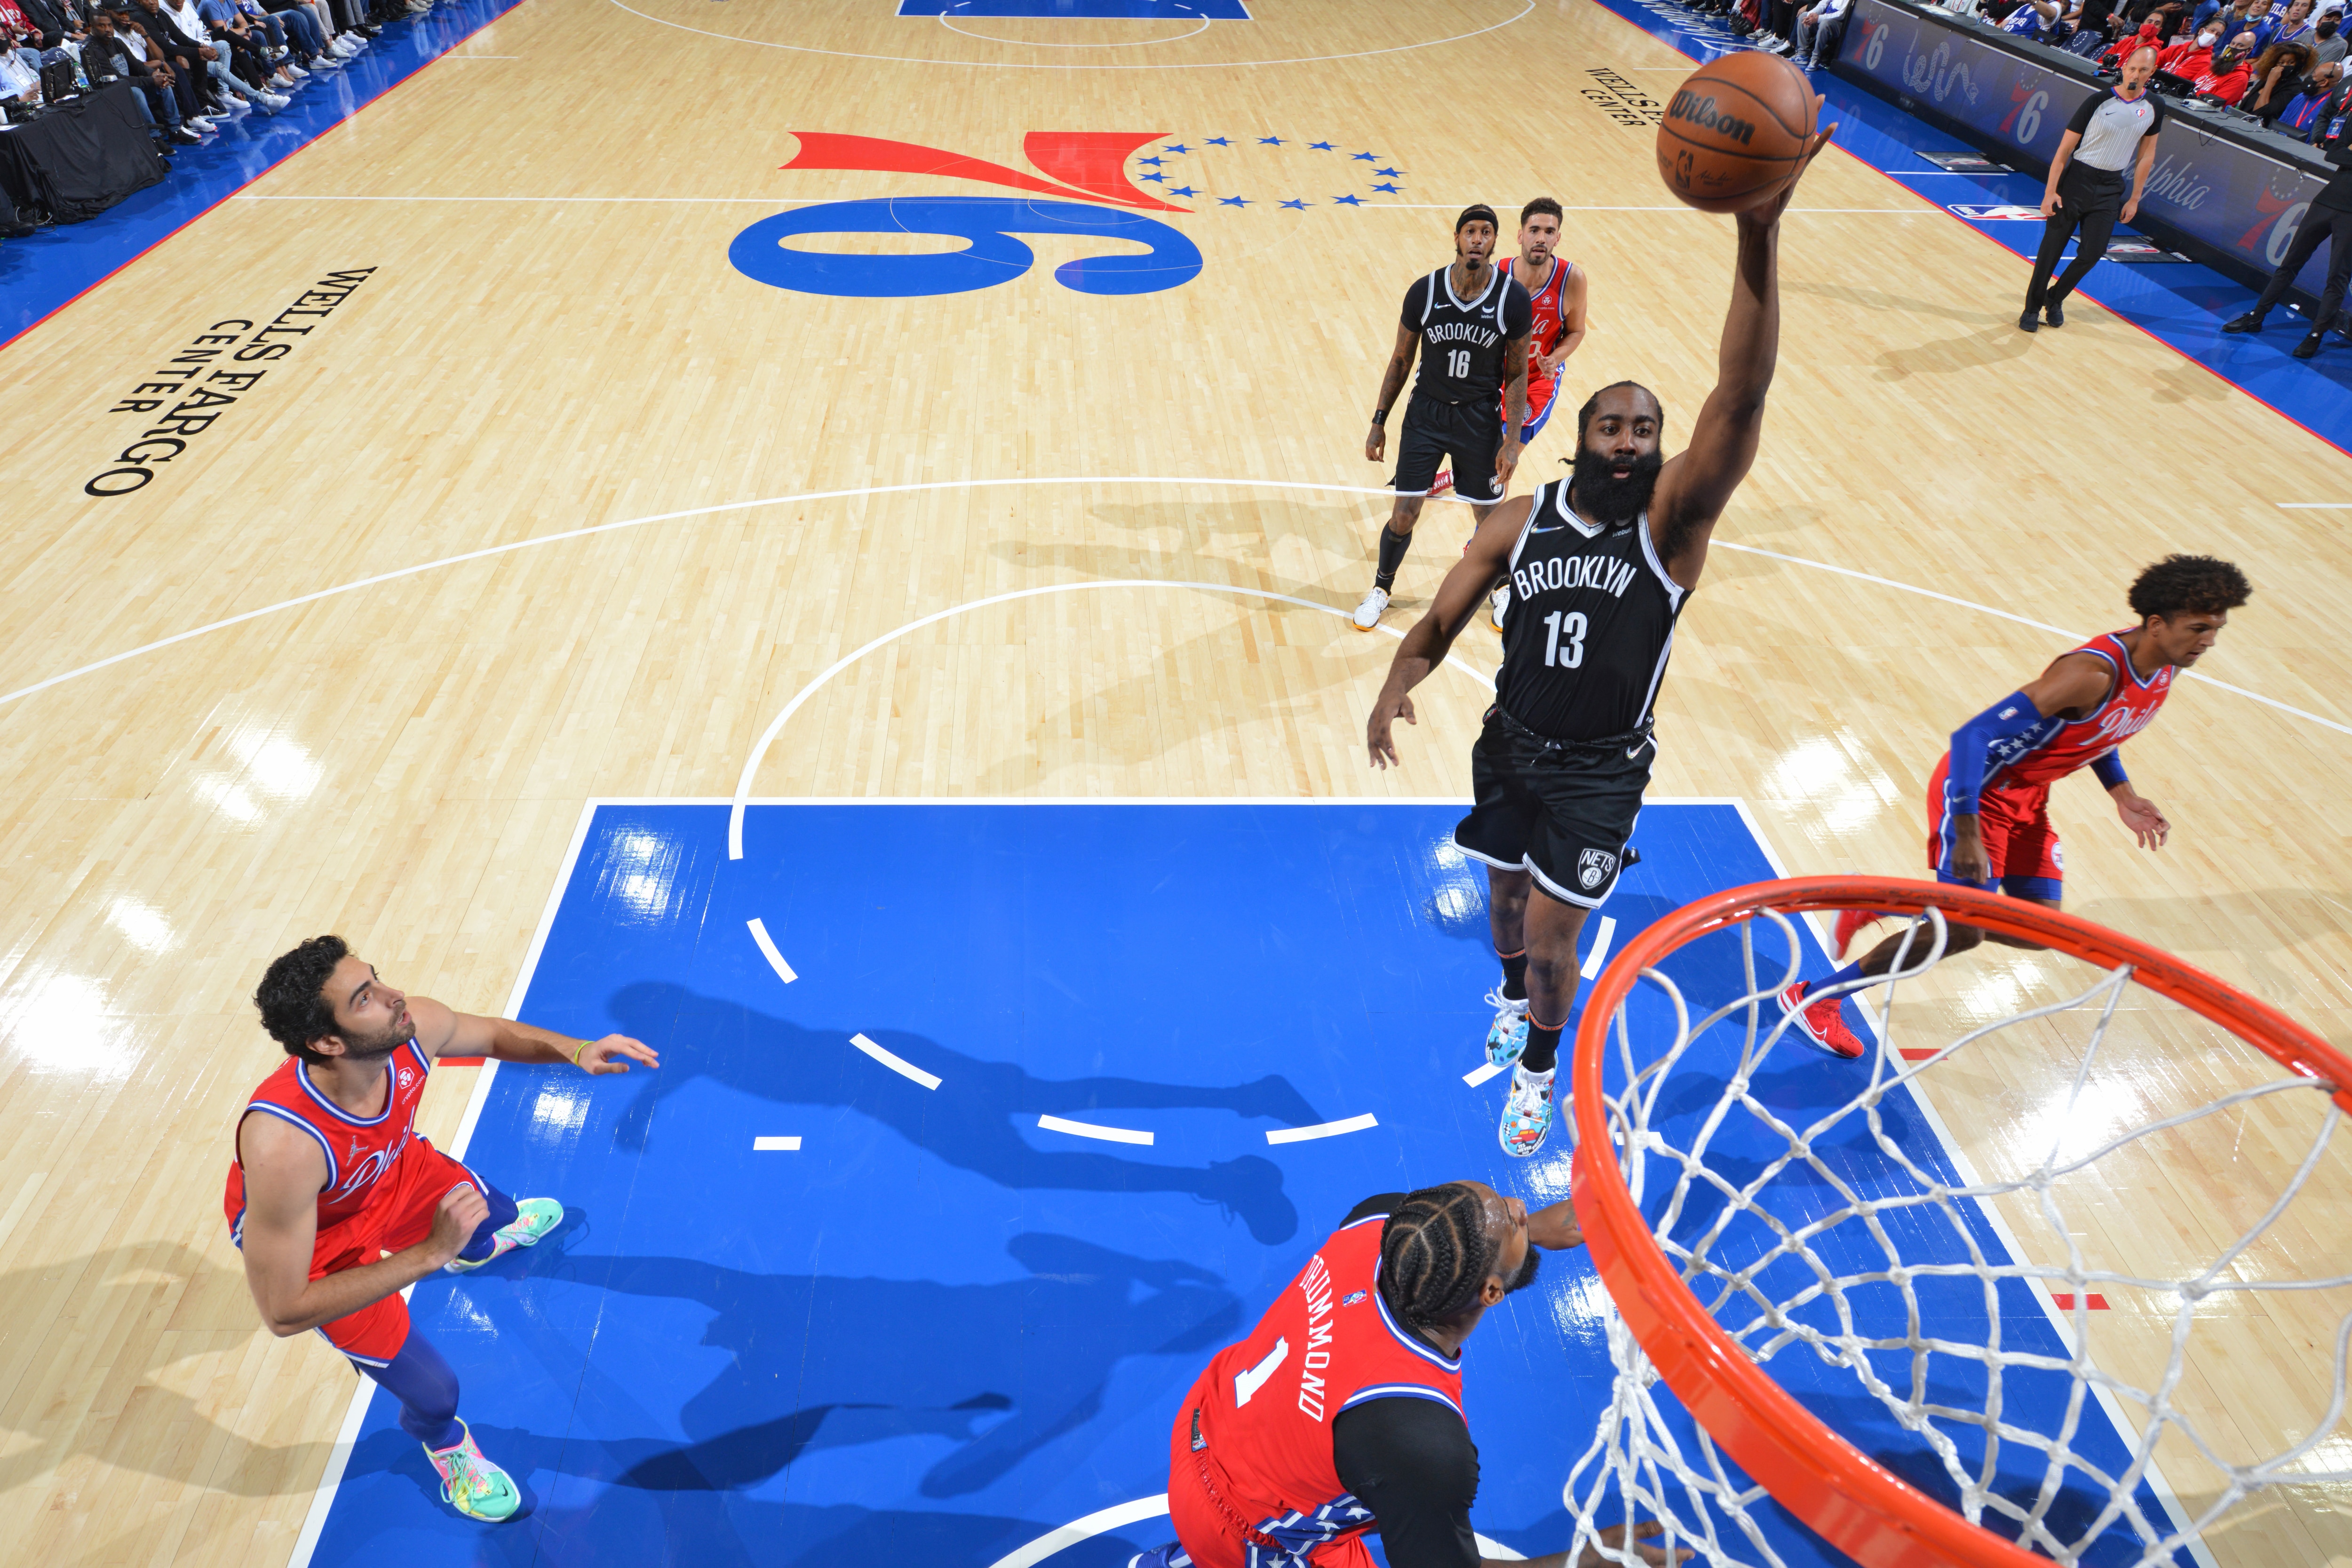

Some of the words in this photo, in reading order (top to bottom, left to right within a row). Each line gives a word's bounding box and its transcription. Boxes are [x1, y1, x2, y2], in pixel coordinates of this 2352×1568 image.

[1580, 89, 1647, 126] CENTER
[1585, 68, 1662, 107] WELLS
[1669, 89, 1755, 145] Wilson
[1999, 80, 2049, 144] 76
[233, 266, 379, 361] WELLS
[1427, 323, 1499, 349] BROOKLYN
[107, 319, 254, 413] CENTER
[1447, 349, 1471, 378] 16
[84, 369, 268, 497] FARGO
[1612, 526, 1632, 538] Webull
[1513, 555, 1637, 601] BROOKLYN
[1543, 611, 1588, 669] 13
[1581, 850, 1614, 873] NETS
[1587, 870, 1597, 883] B
[402, 1075, 425, 1105] crypto.com
[1532, 1127, 1546, 1150] PRESSURE
[1298, 1254, 1334, 1422] DRUMMOND
[1233, 1336, 1288, 1408] 1
